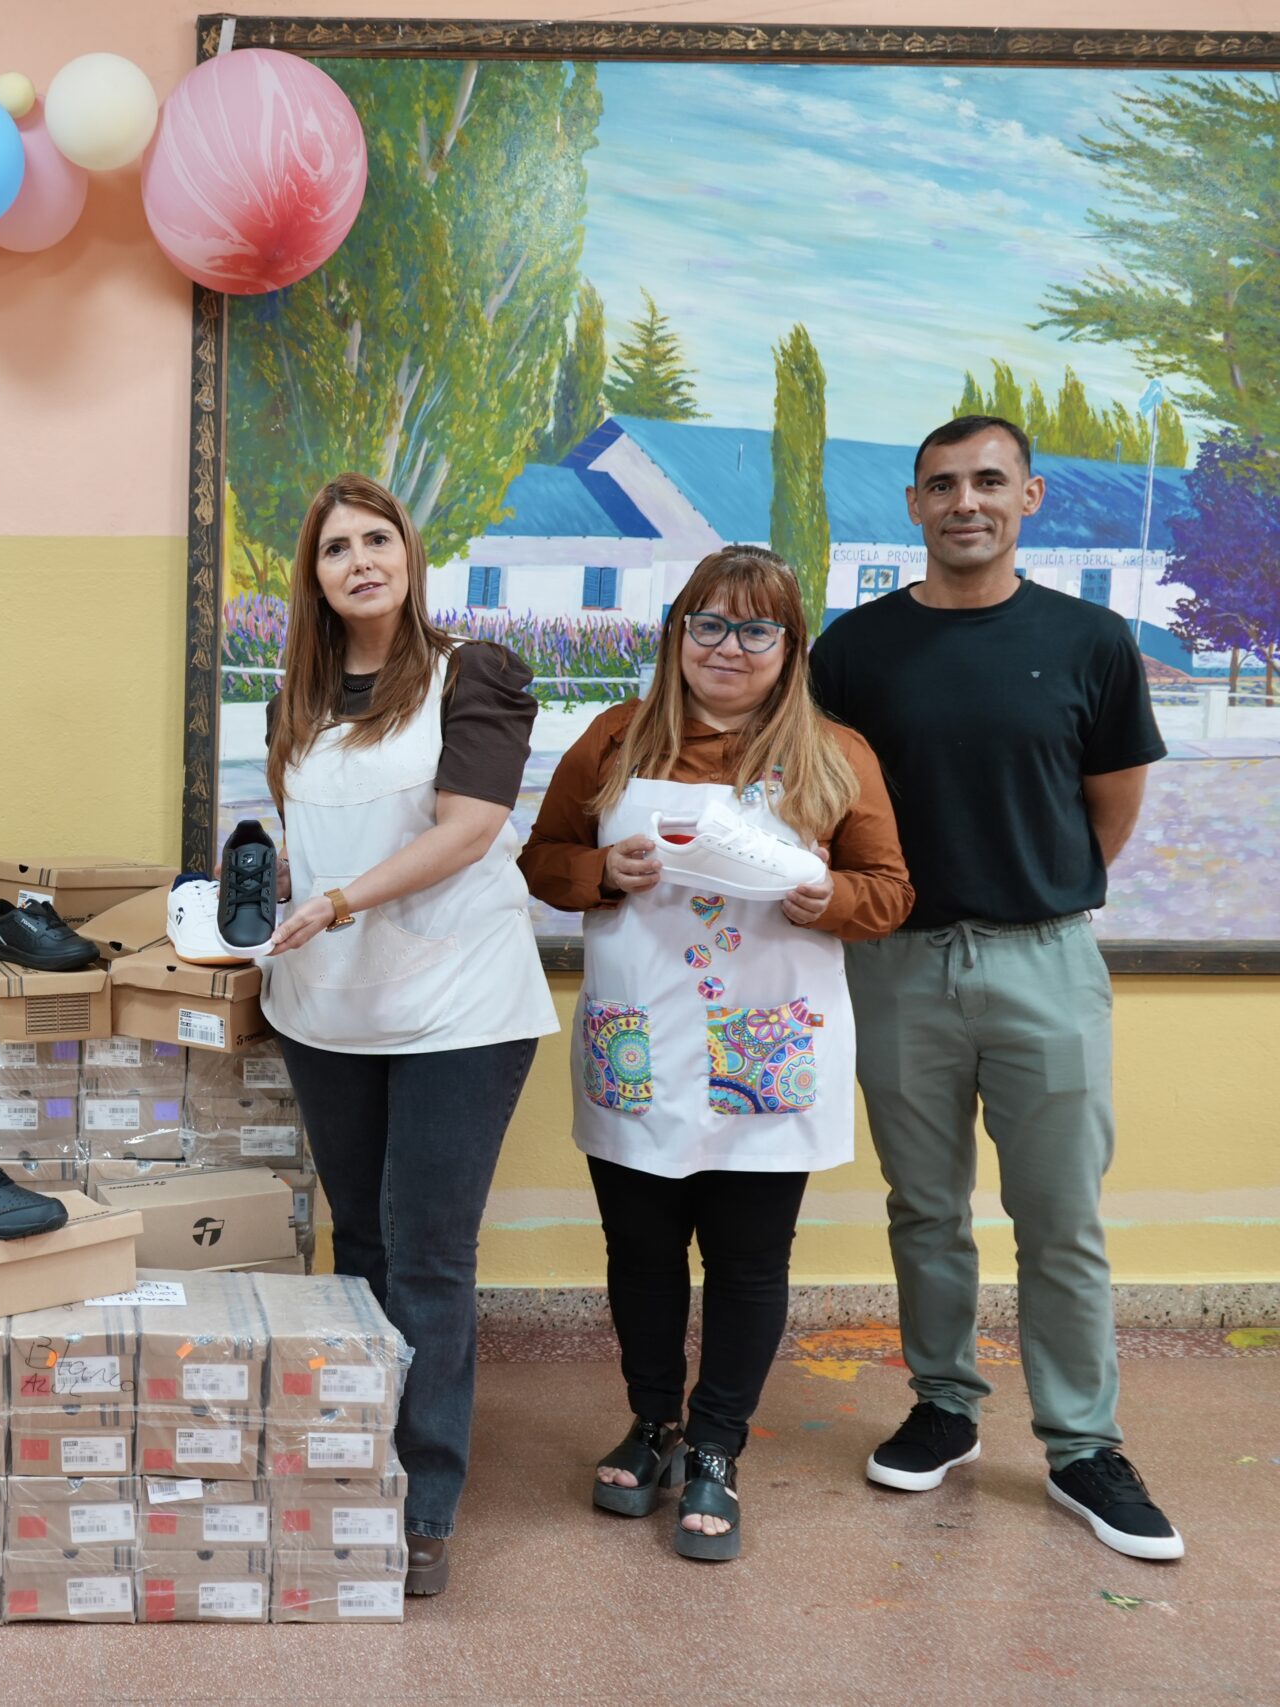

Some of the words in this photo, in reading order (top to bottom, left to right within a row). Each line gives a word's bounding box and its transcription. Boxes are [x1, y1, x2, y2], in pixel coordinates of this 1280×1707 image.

[833, 550, 879, 561] ESCUELA
[1025, 553, 1065, 566] POLICIA
[1070, 554, 1116, 567] FEDERAL
